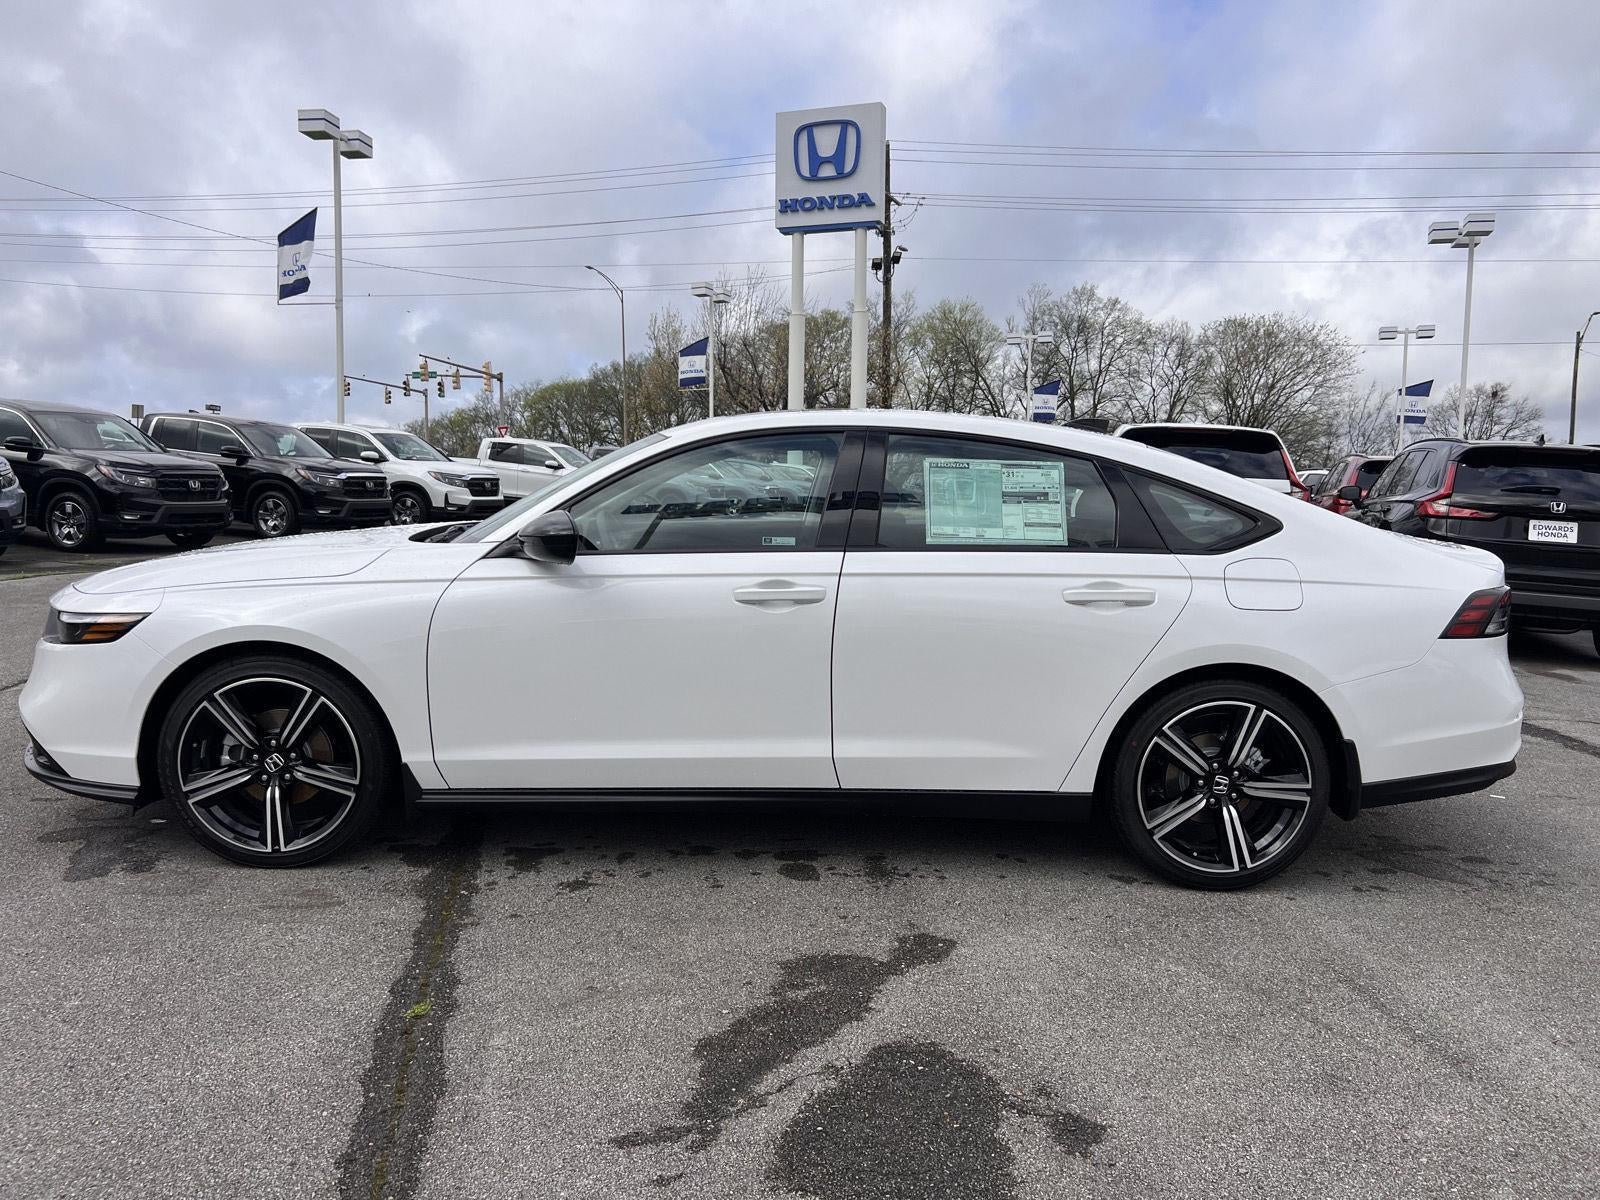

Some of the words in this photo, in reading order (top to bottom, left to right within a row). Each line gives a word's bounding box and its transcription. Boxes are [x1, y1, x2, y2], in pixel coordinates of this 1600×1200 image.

[778, 192, 876, 213] HONDA
[1532, 524, 1574, 533] EDWARDS
[1537, 531, 1569, 539] HONDA
